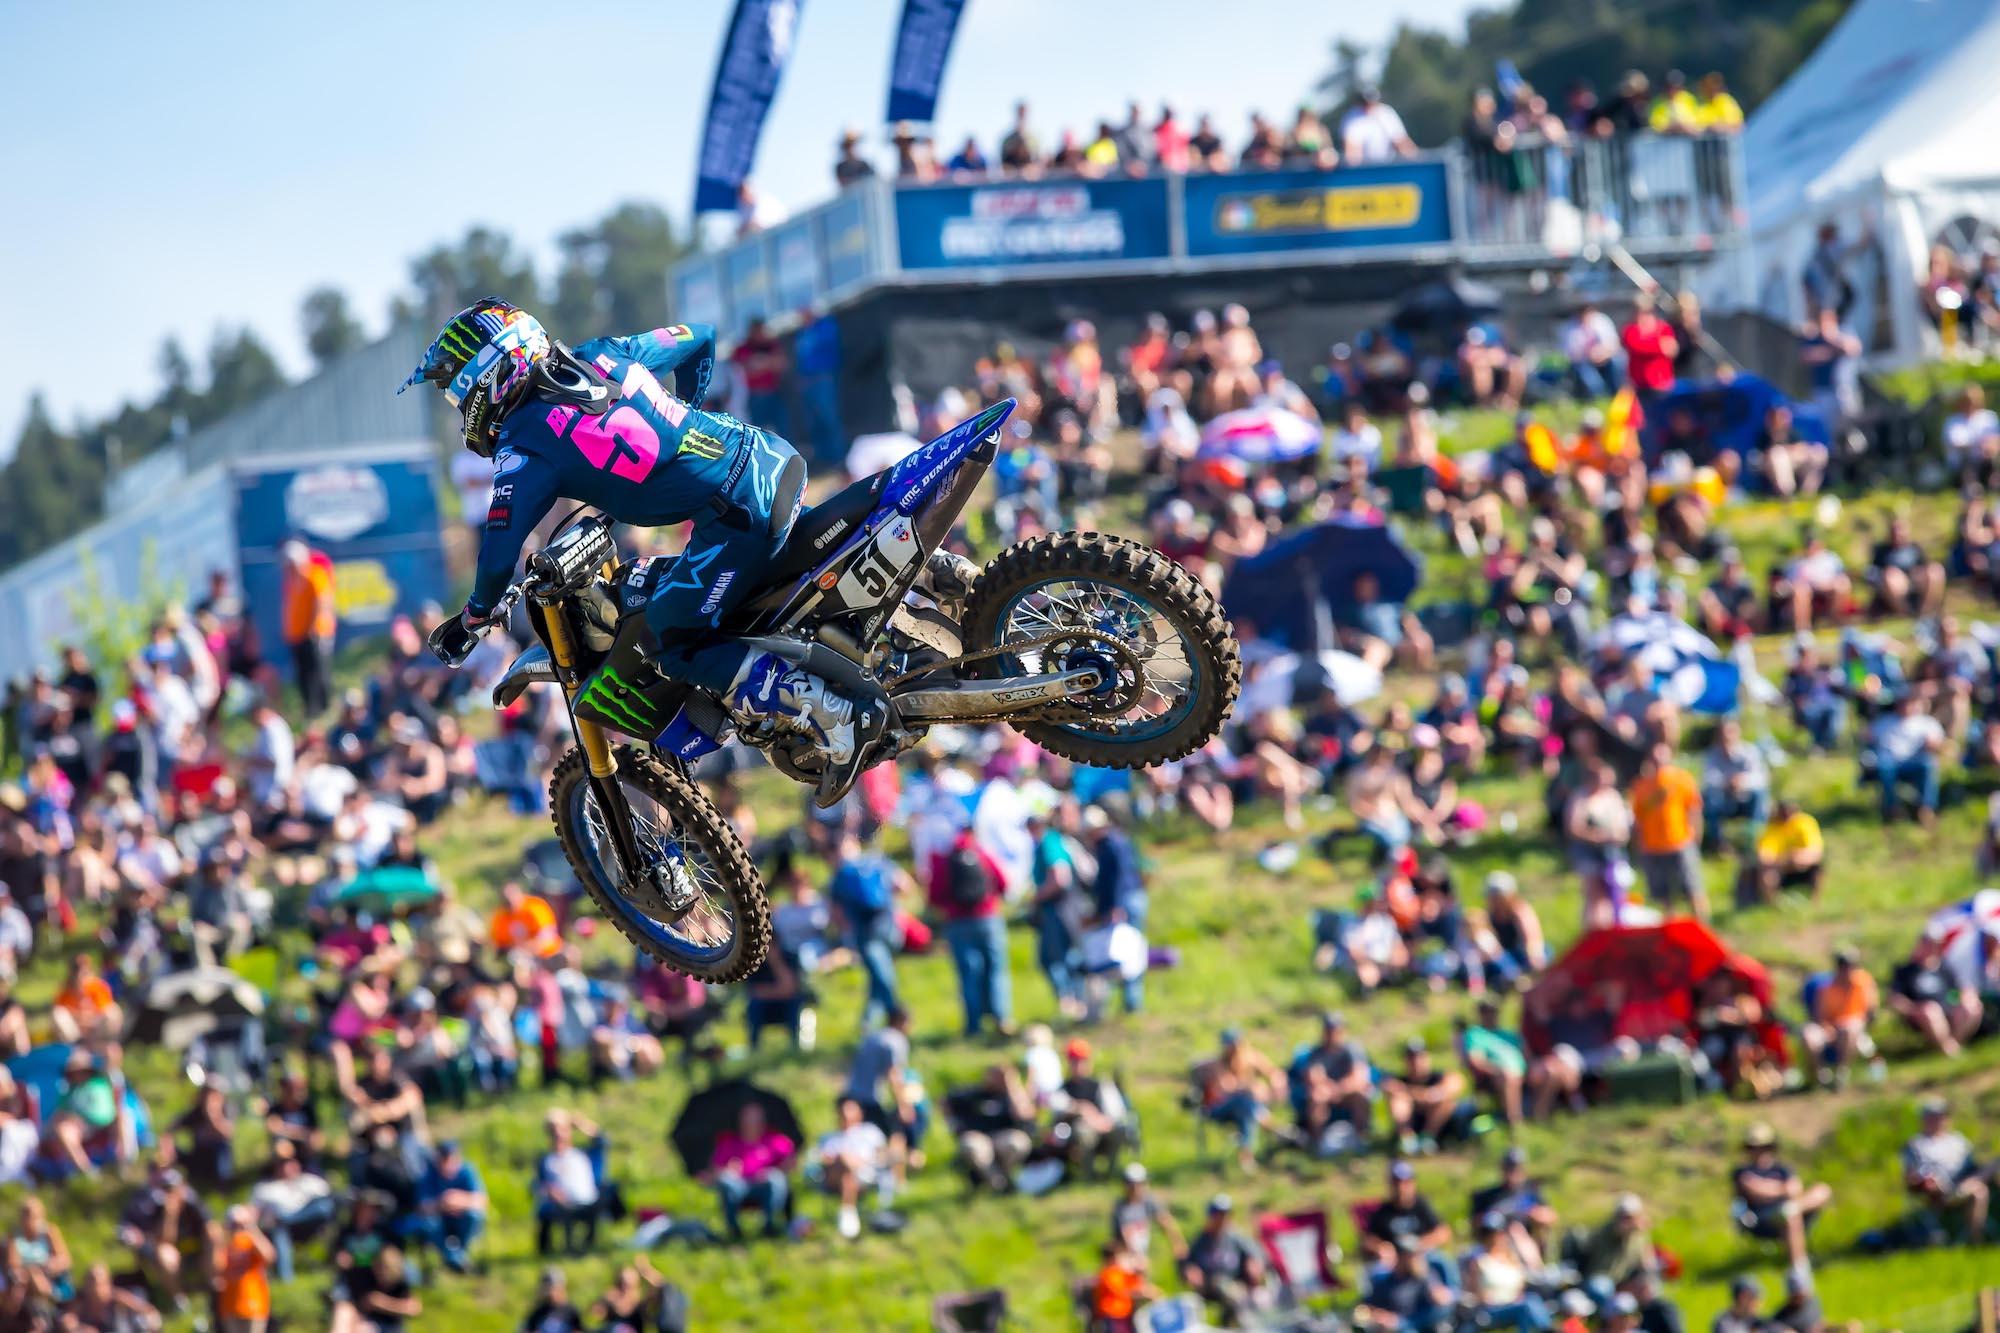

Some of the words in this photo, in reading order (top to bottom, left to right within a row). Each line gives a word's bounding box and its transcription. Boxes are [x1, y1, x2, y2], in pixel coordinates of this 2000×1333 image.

[467, 390, 485, 431] MONSTER
[570, 361, 689, 485] 51
[921, 442, 965, 488] DUNLOP
[899, 484, 921, 509] KMC
[557, 525, 605, 567] RENTHAL
[820, 518, 849, 545] YAMAHA
[562, 533, 609, 575] RENTHAL
[850, 537, 900, 598] 51
[706, 570, 736, 604] YAMAHA
[991, 686, 1049, 705] VORTEX
